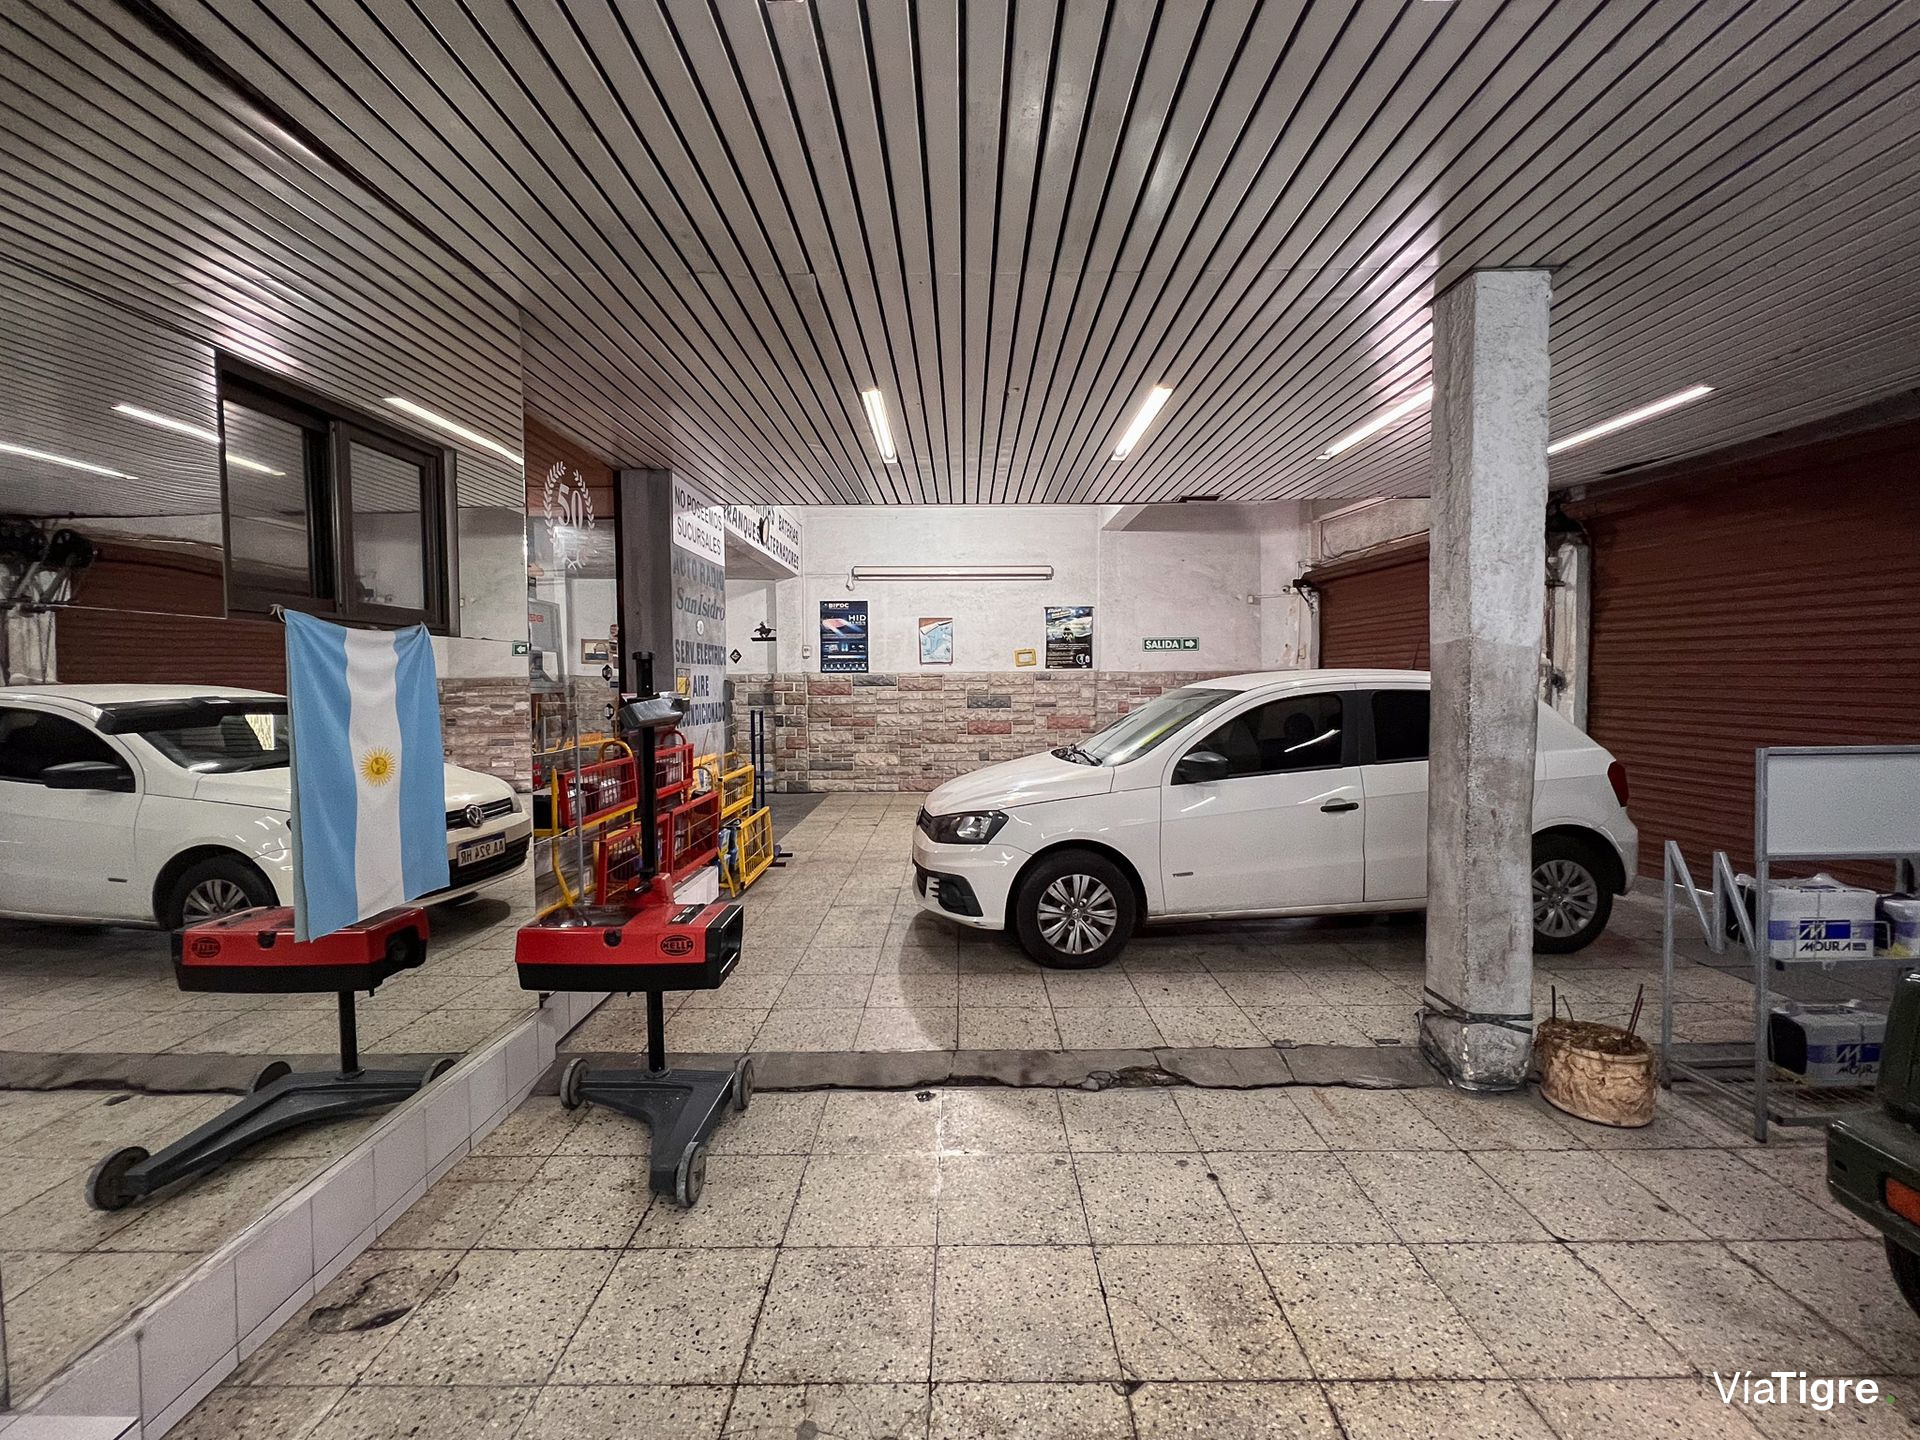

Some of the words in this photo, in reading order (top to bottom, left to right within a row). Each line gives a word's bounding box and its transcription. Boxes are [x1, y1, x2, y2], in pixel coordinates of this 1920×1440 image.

[558, 484, 584, 529] 50
[674, 485, 686, 508] NO
[687, 494, 722, 531] POSEEMOS
[677, 516, 721, 555] SUCURSALES
[673, 556, 698, 581] AUTO
[700, 563, 725, 591] RADIO
[1145, 640, 1179, 649] SALIDA
[693, 675, 709, 697] AIRE
[661, 940, 694, 949] HELLA
[1799, 941, 1851, 951] MOURA
